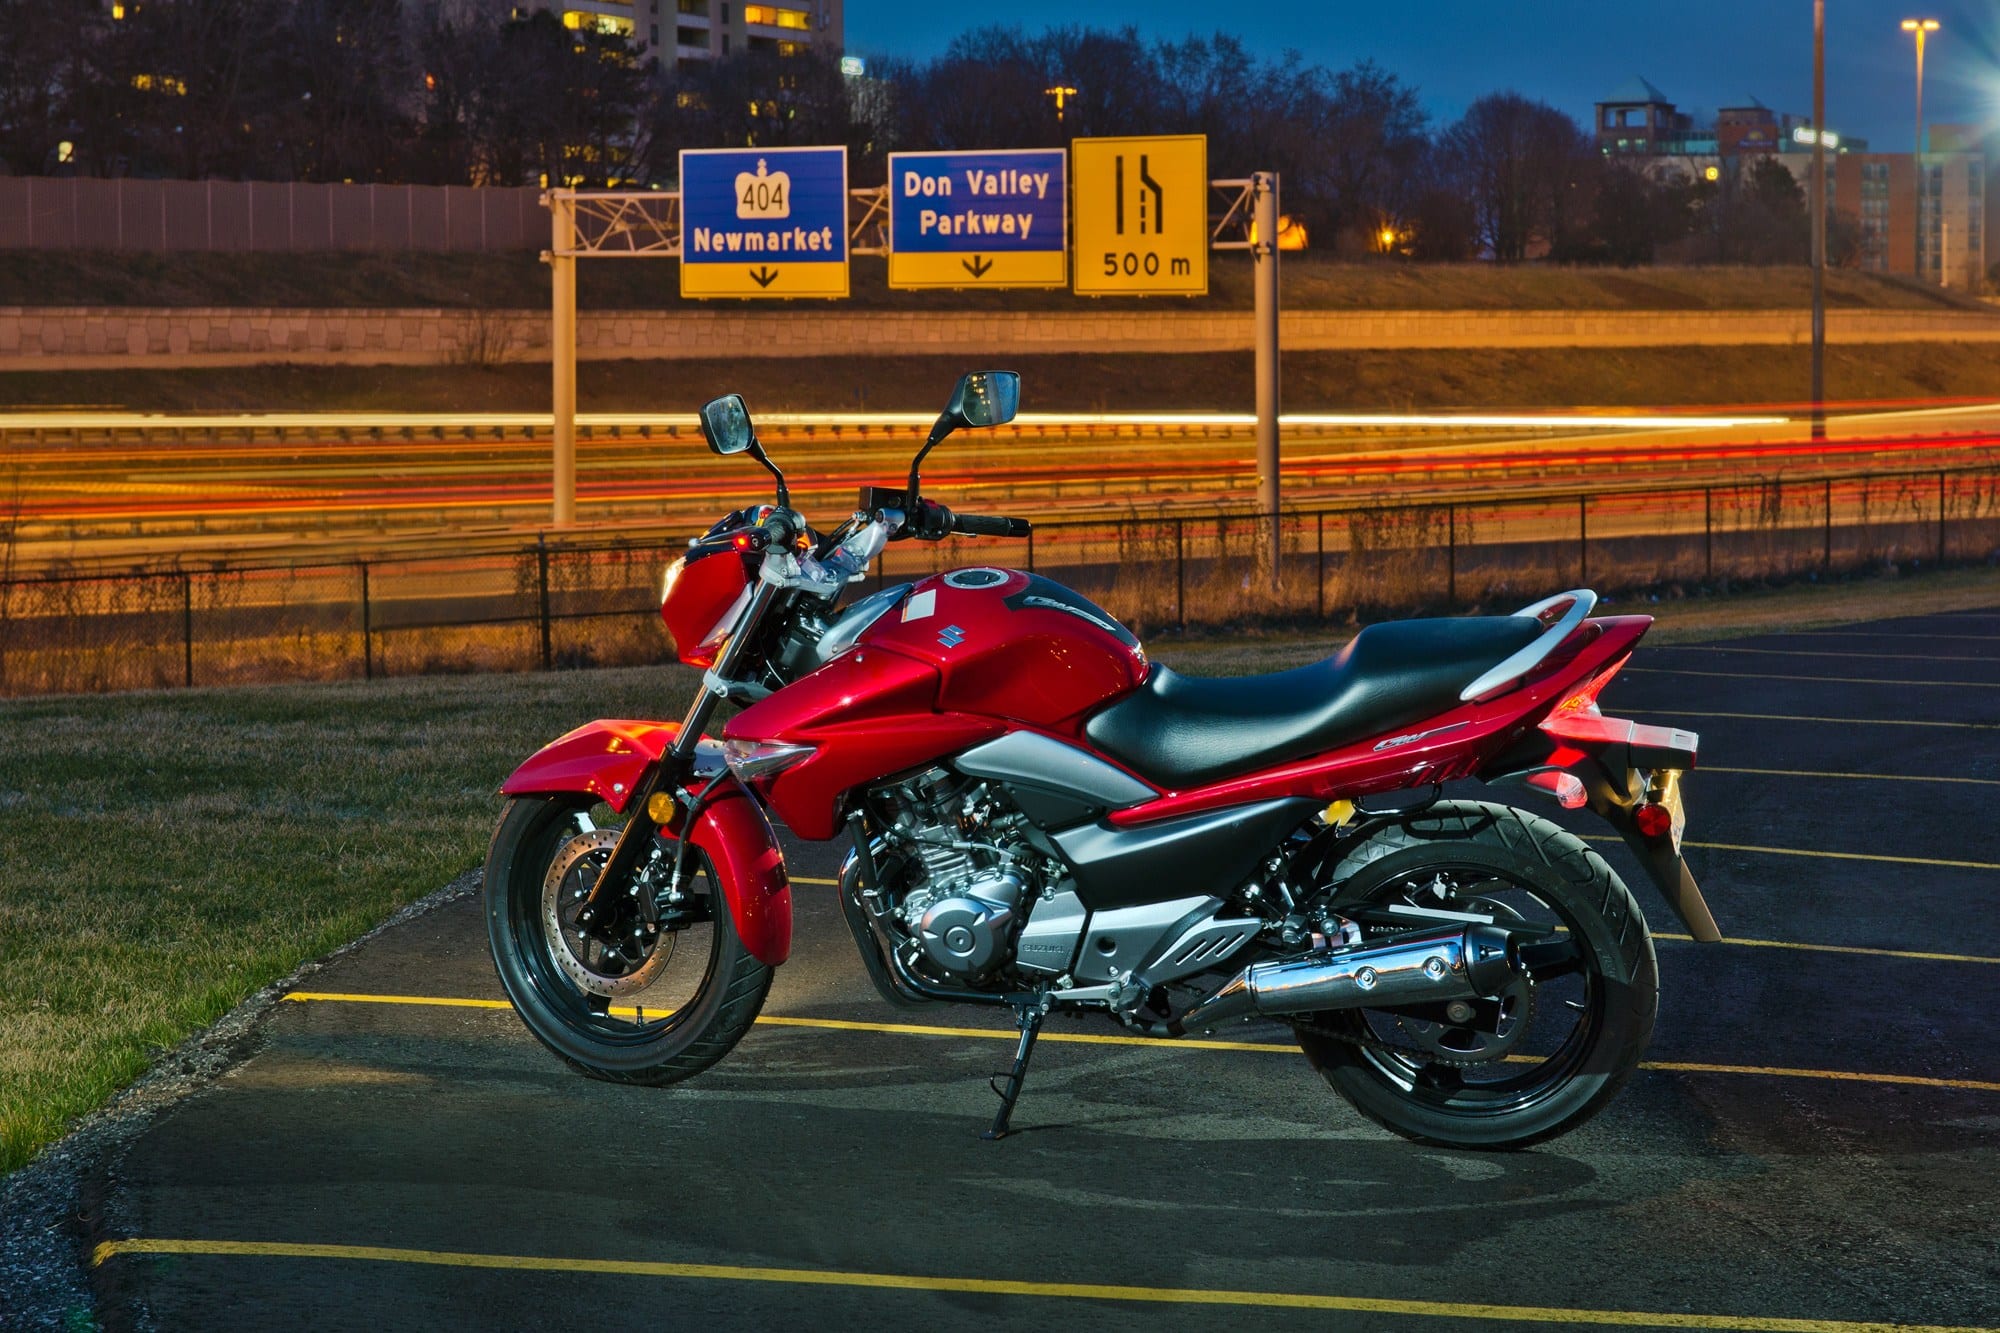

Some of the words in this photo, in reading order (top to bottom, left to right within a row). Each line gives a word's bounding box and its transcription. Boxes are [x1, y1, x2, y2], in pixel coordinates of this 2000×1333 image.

[742, 182, 784, 212] 404
[904, 171, 952, 197] Don
[966, 169, 1049, 199] Valley
[920, 209, 1033, 240] Parkway
[693, 226, 833, 252] Newmarket
[1104, 252, 1160, 276] 500
[1171, 257, 1191, 276] m
[1022, 944, 1064, 953] SUZUKI
